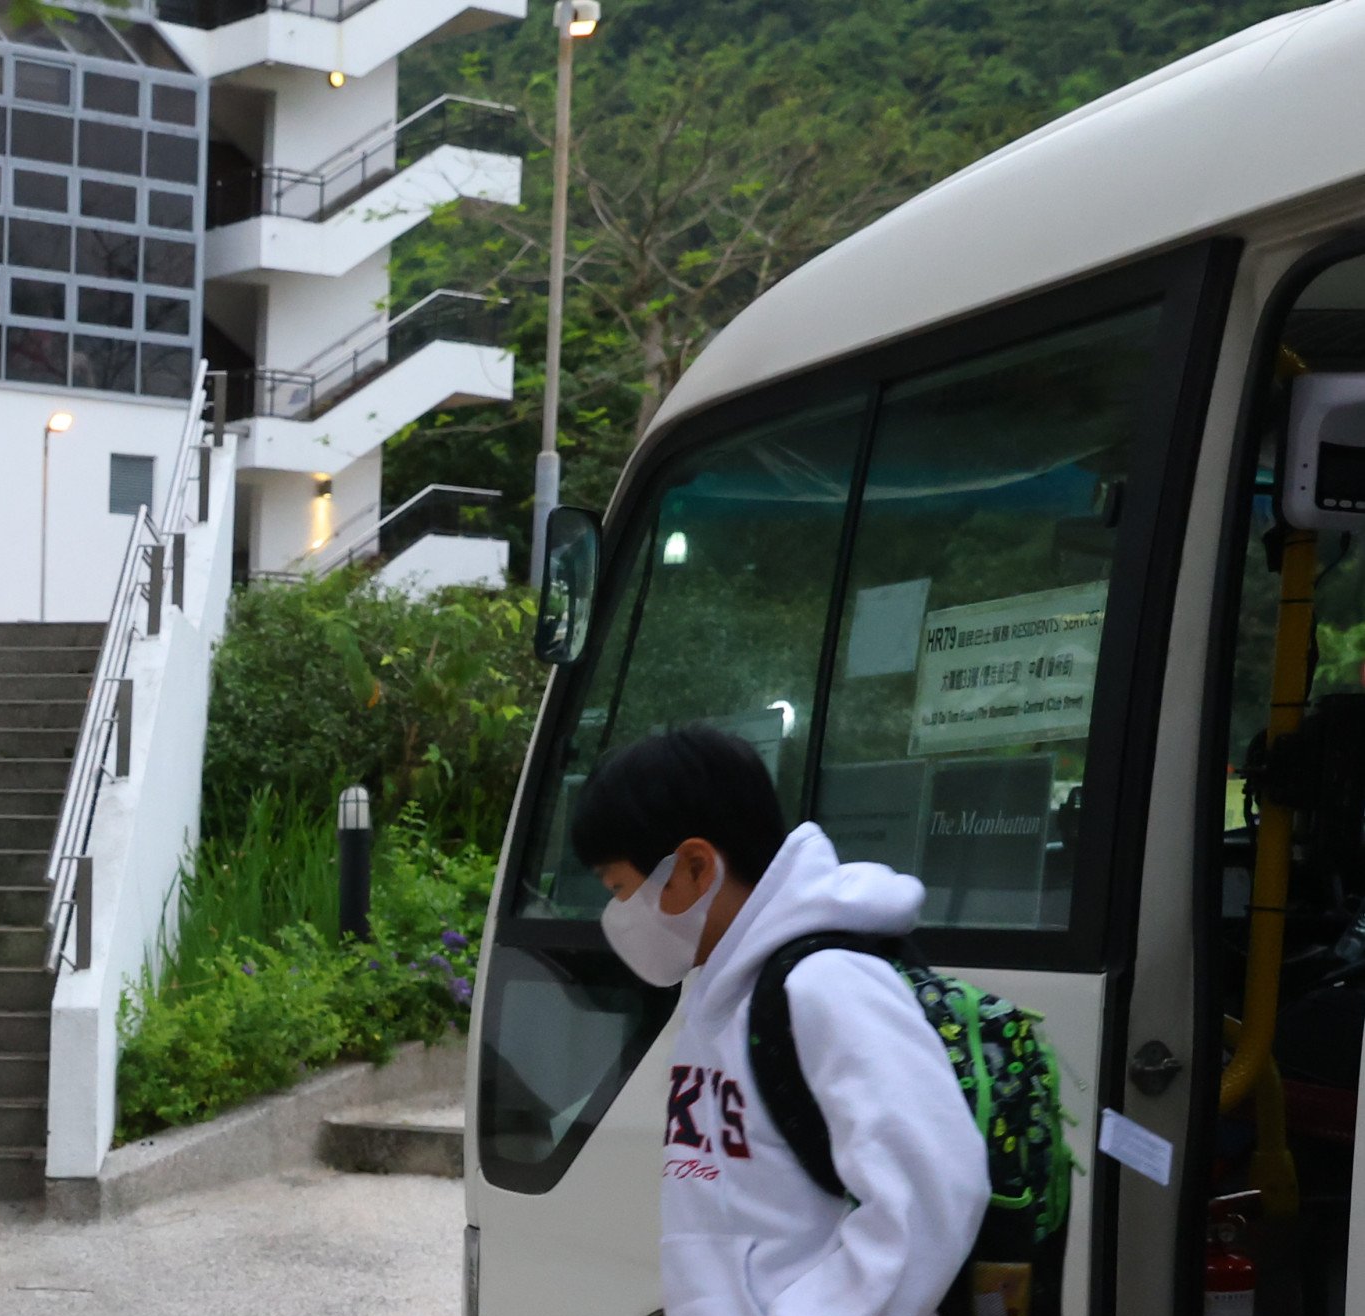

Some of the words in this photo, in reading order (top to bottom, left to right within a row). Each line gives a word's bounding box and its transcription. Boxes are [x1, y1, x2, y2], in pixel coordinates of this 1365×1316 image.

[927, 626, 957, 653] HR79
[930, 811, 954, 835] The
[957, 810, 1041, 835] Manhattan
